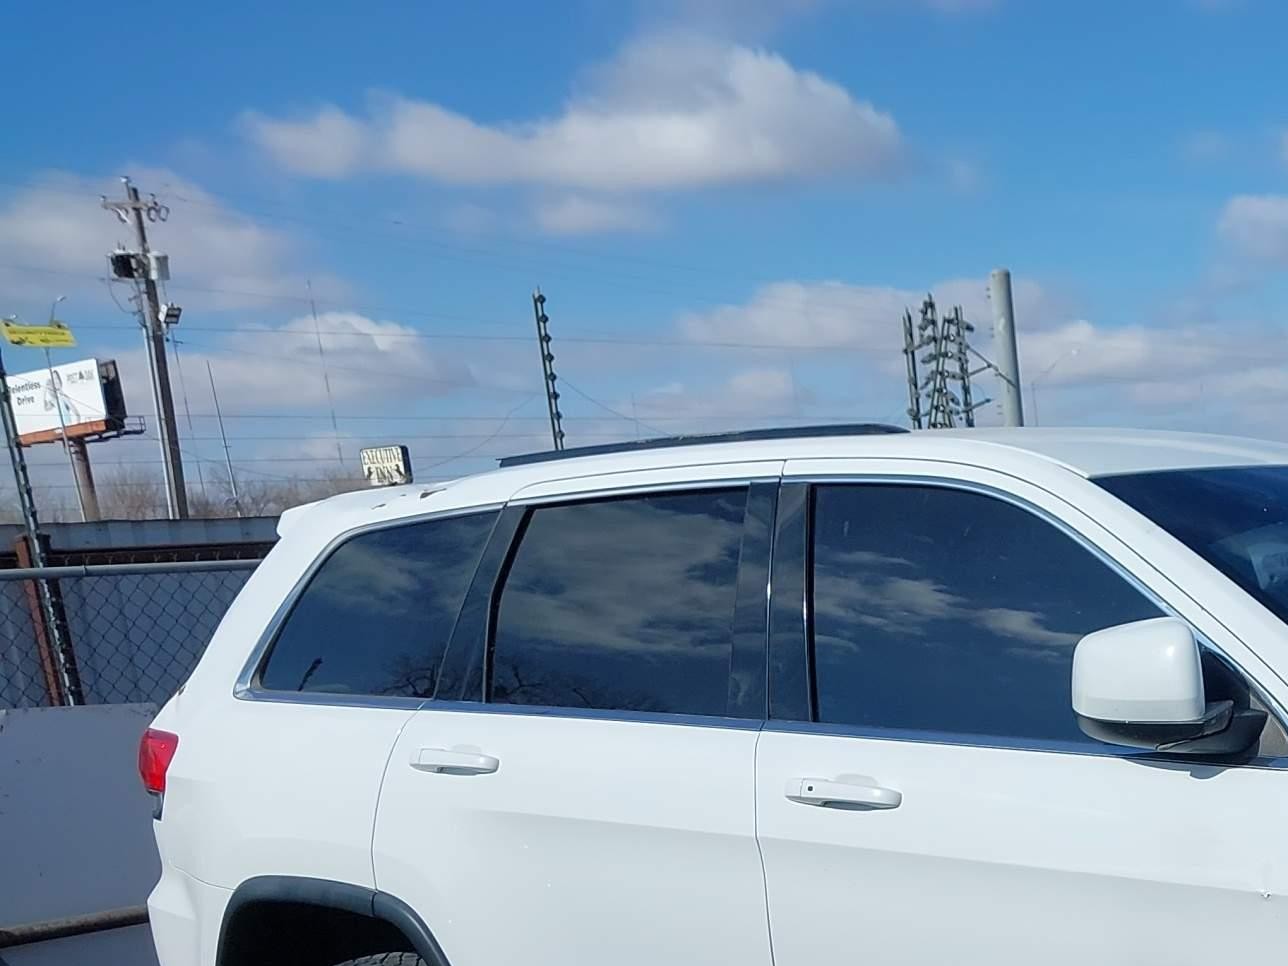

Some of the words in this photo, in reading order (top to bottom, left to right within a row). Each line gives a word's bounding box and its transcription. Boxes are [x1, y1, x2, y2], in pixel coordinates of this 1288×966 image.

[17, 395, 35, 406] Drive
[362, 447, 402, 466] EXECUTIVE
[374, 465, 394, 484] INN
